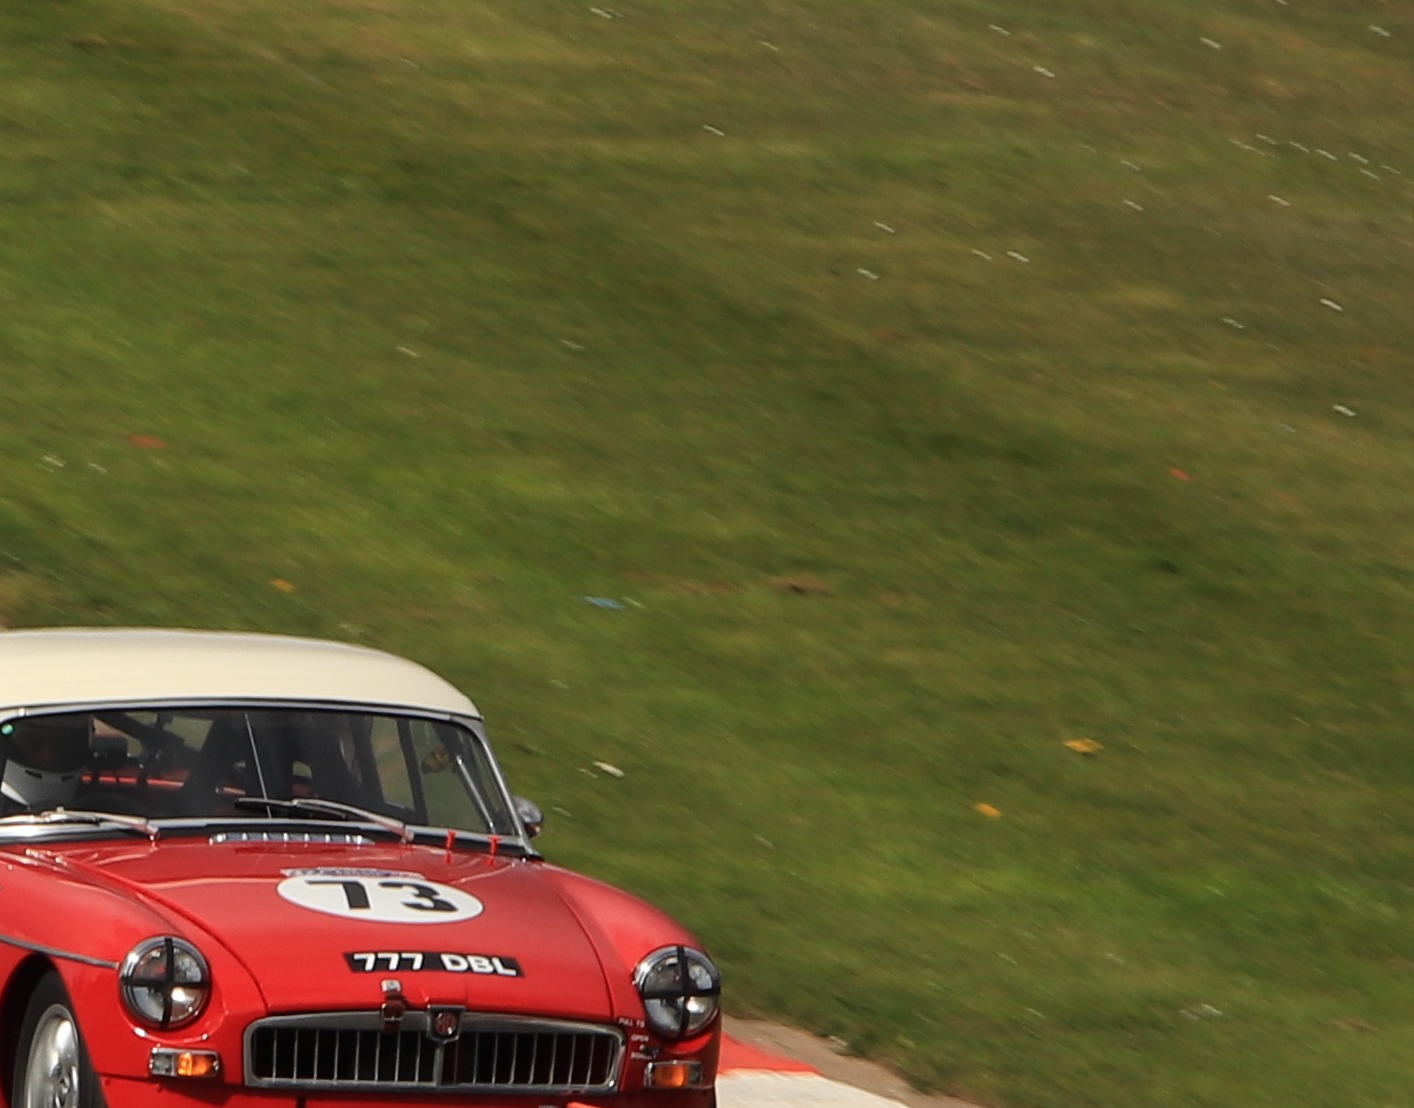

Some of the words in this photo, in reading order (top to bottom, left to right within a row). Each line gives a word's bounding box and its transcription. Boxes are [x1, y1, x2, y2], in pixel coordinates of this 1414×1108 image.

[305, 880, 458, 911] 73
[353, 953, 423, 971] 777
[440, 954, 517, 976] DBL
